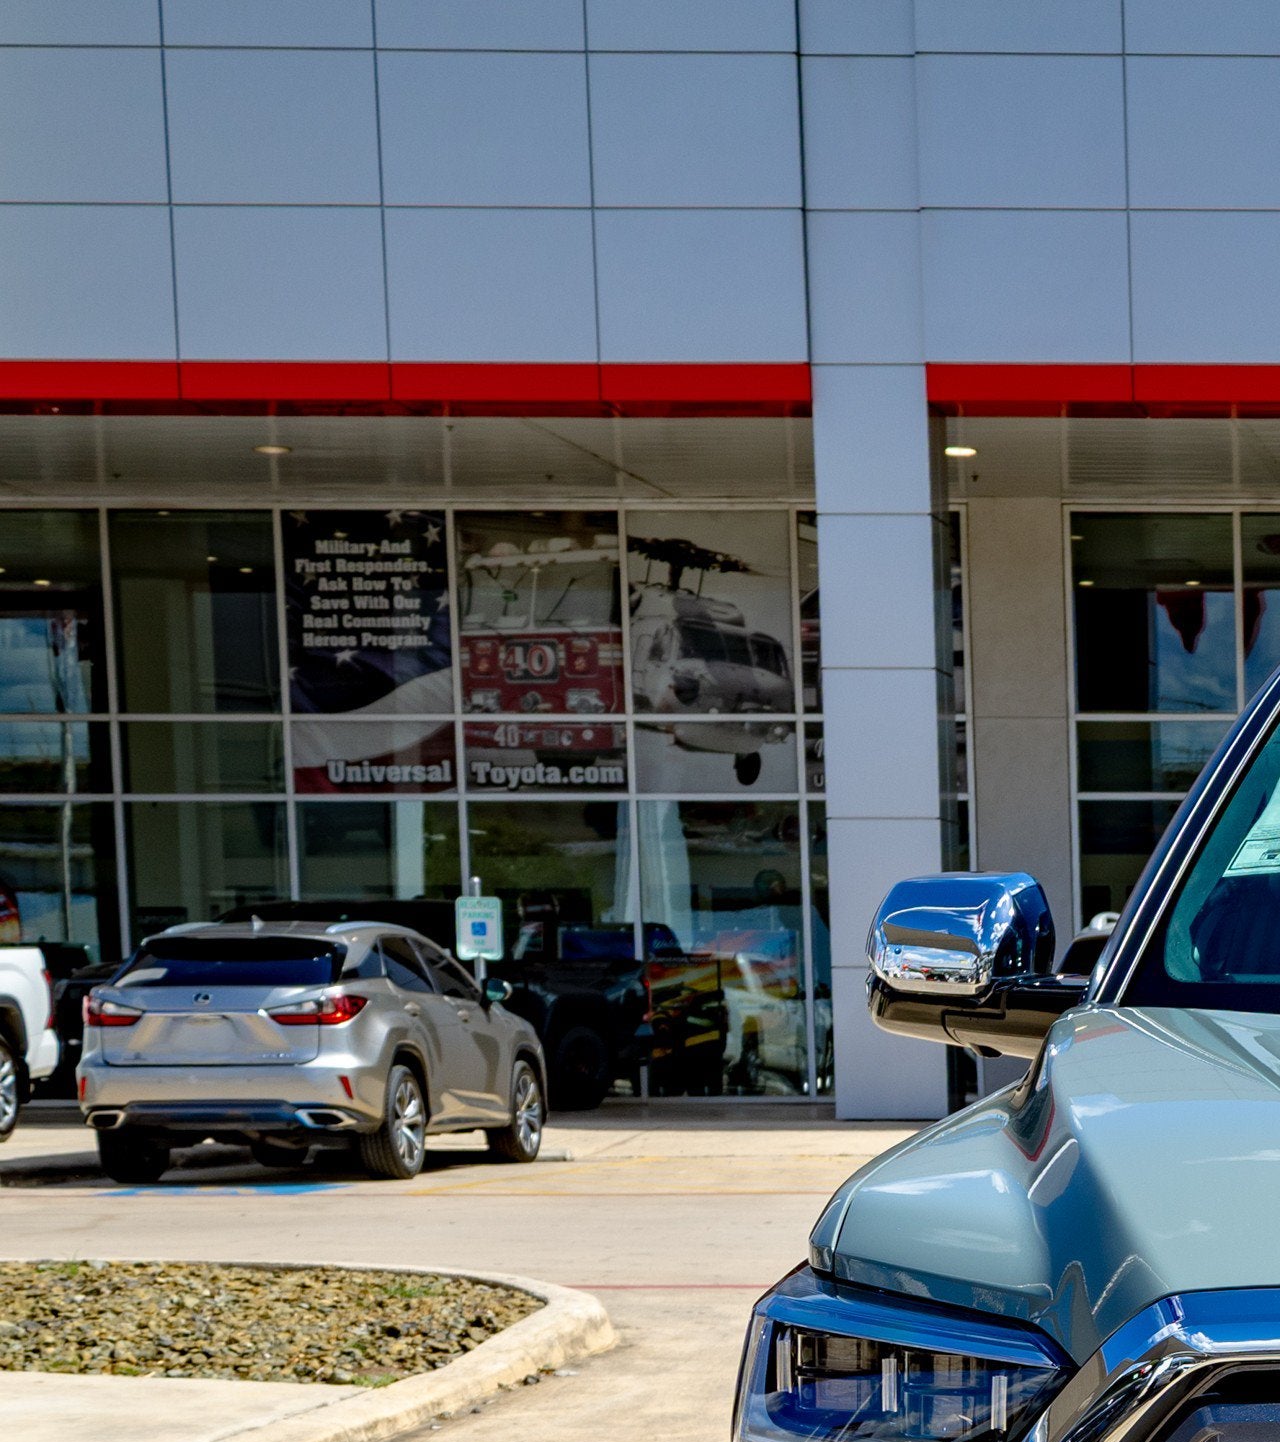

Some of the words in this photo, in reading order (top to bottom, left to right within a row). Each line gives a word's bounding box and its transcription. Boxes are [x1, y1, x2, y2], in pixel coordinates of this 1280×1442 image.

[315, 539, 376, 557] Military
[380, 539, 411, 554] And
[294, 558, 332, 573] First
[318, 577, 348, 591] Ask
[352, 577, 387, 591] How
[390, 577, 412, 591] To
[310, 595, 350, 610] Save
[353, 595, 390, 610] With
[393, 595, 421, 610] Our
[303, 614, 337, 629] Real
[342, 614, 431, 631] Community
[303, 633, 357, 647] Heroes
[361, 633, 433, 649] Program.
[503, 644, 555, 677] 40
[493, 723, 520, 747] 40
[326, 759, 452, 783] Universal
[470, 761, 625, 789] Toyota.com
